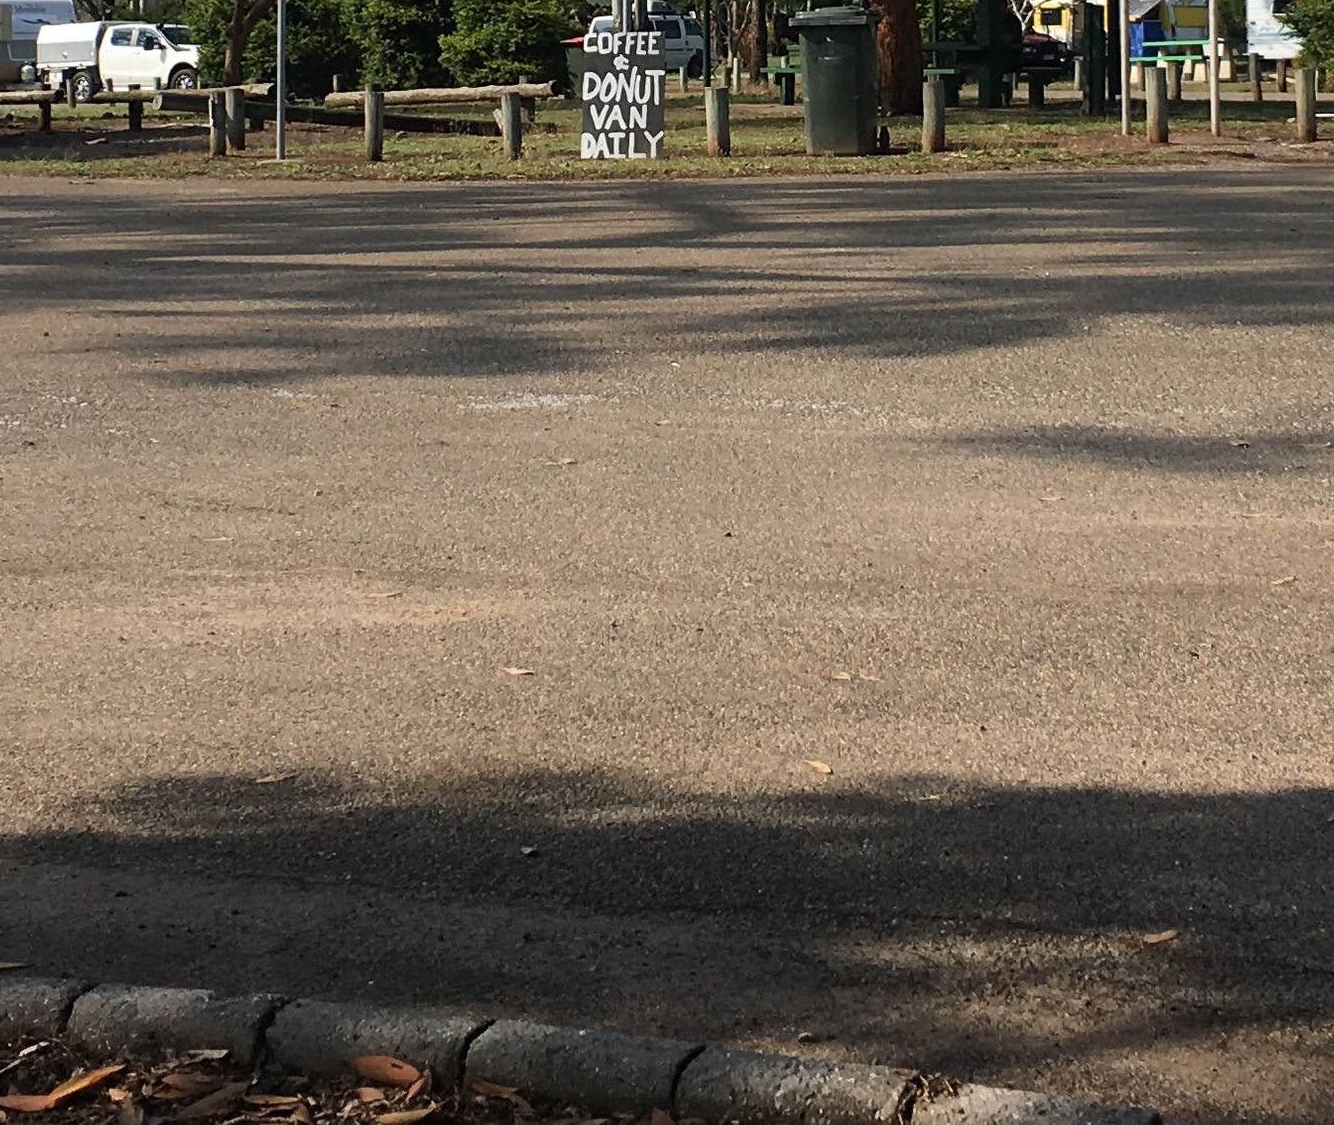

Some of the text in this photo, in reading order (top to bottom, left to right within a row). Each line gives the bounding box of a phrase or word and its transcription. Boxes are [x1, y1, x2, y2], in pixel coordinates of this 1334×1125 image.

[583, 31, 662, 55] COFFEE
[613, 54, 629, 71] &
[582, 66, 665, 105] DONUT
[590, 104, 648, 130] VAN
[580, 130, 664, 159] DAILY
